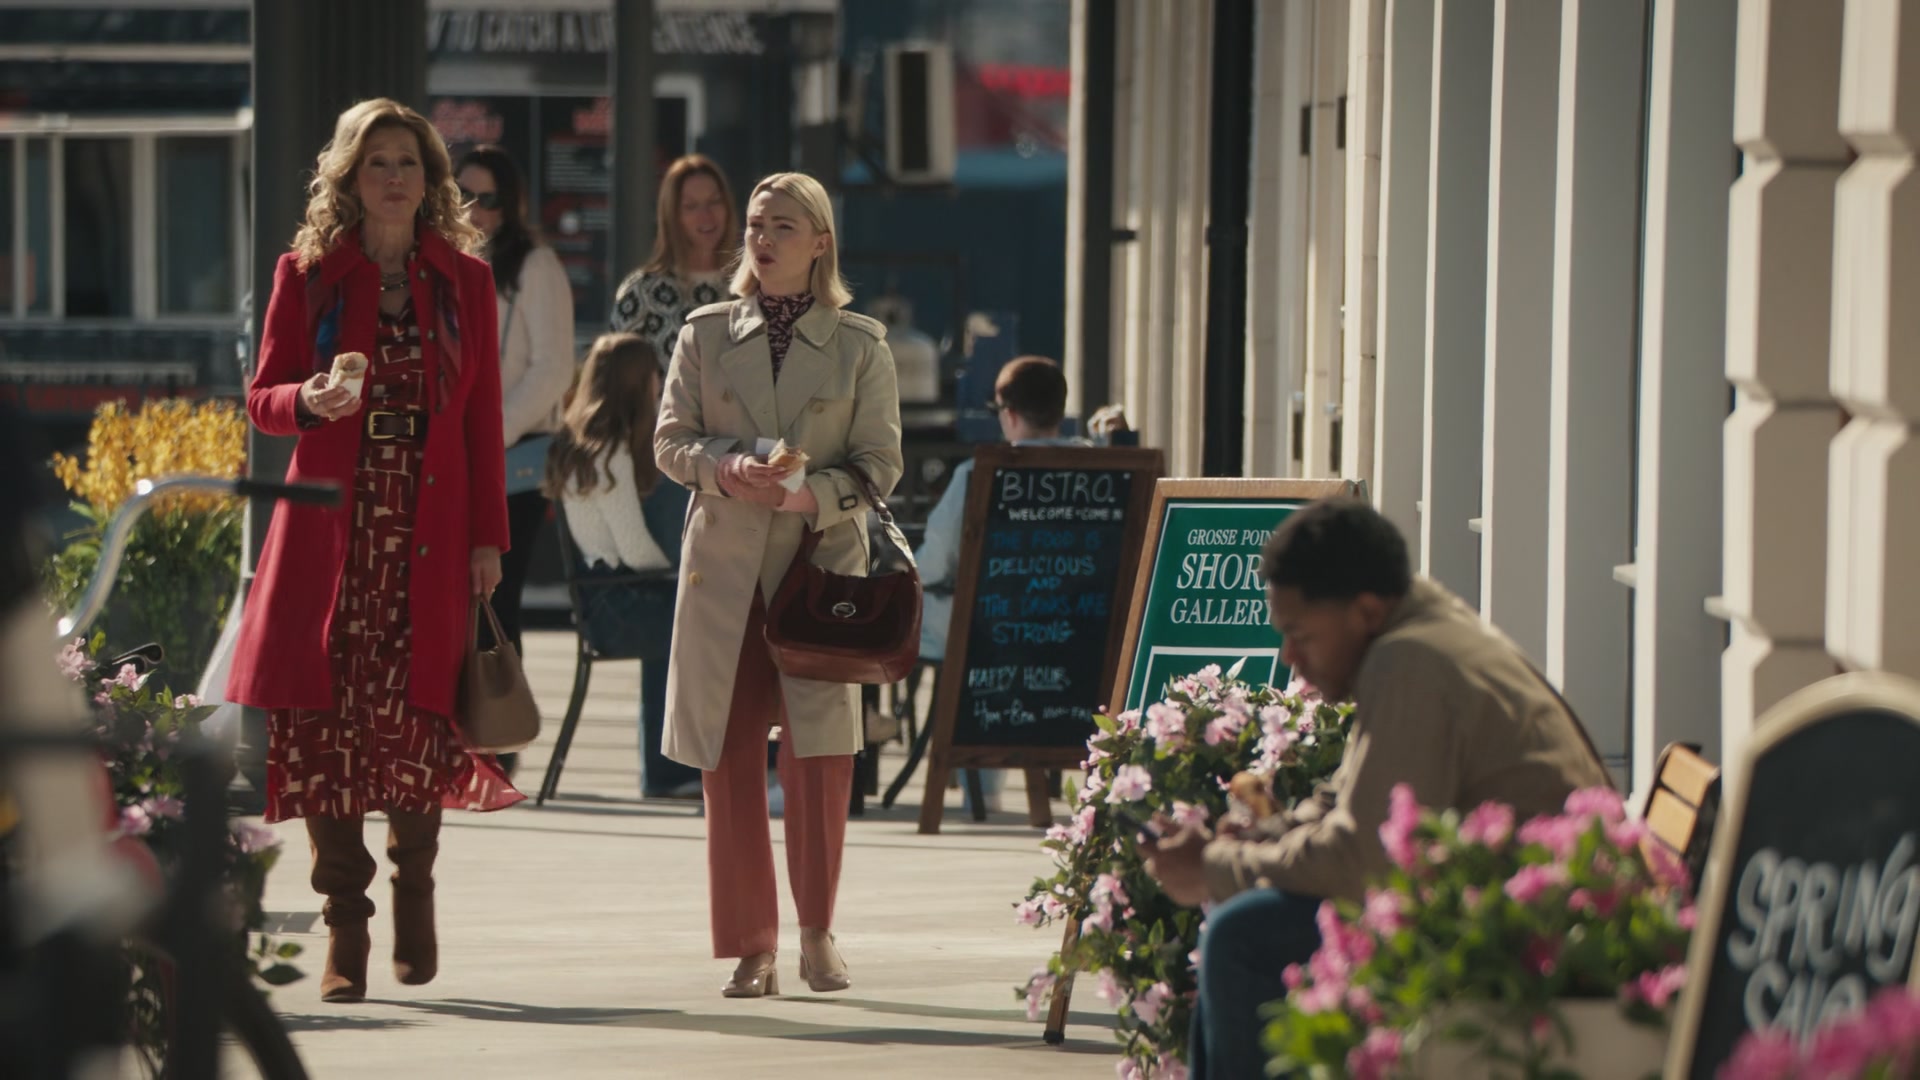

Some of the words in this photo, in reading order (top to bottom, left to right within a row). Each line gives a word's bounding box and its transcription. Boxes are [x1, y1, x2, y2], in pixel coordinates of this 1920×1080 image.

[1008, 507, 1075, 521] WELCOME
[1187, 529, 1238, 546] GROSSE
[1240, 529, 1278, 546] POIN
[988, 555, 1096, 577] DELICIOUS
[1176, 553, 1272, 591] SHOR
[1026, 577, 1062, 593] AND
[992, 620, 1074, 645] STRONG
